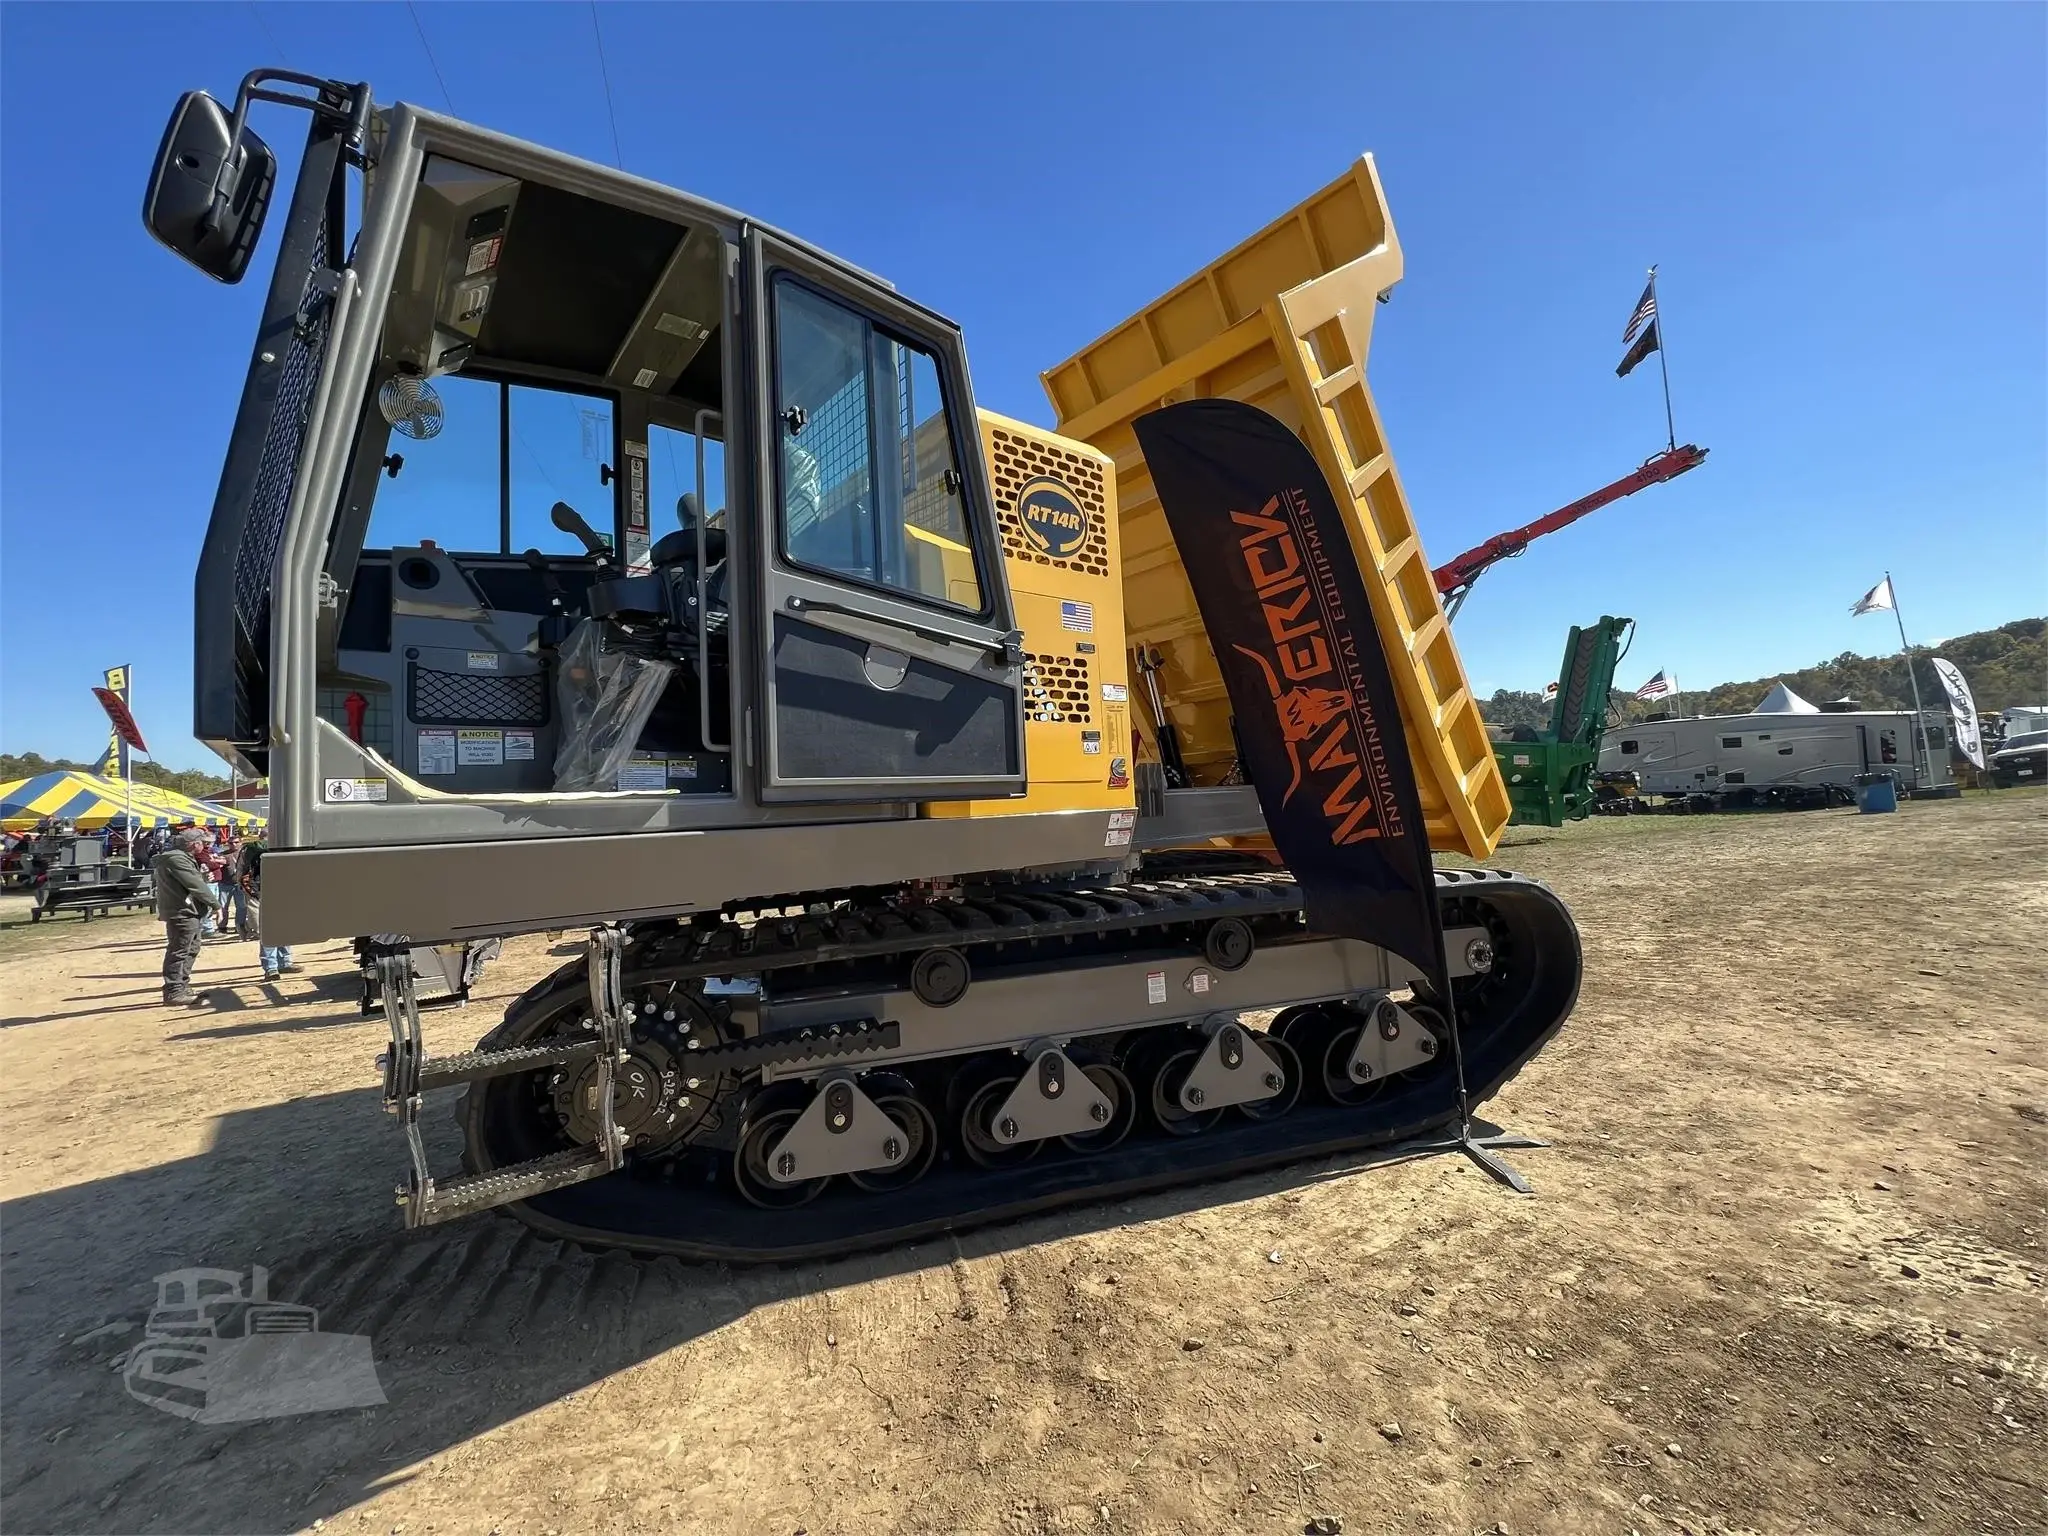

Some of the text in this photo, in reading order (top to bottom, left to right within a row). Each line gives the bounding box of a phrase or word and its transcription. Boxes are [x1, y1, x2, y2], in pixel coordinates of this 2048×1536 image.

[1027, 503, 1080, 531] RT14R
[1291, 487, 1405, 838] ENVIRONMENTAL EQUIPMENT
[630, 1072, 646, 1098] OK
